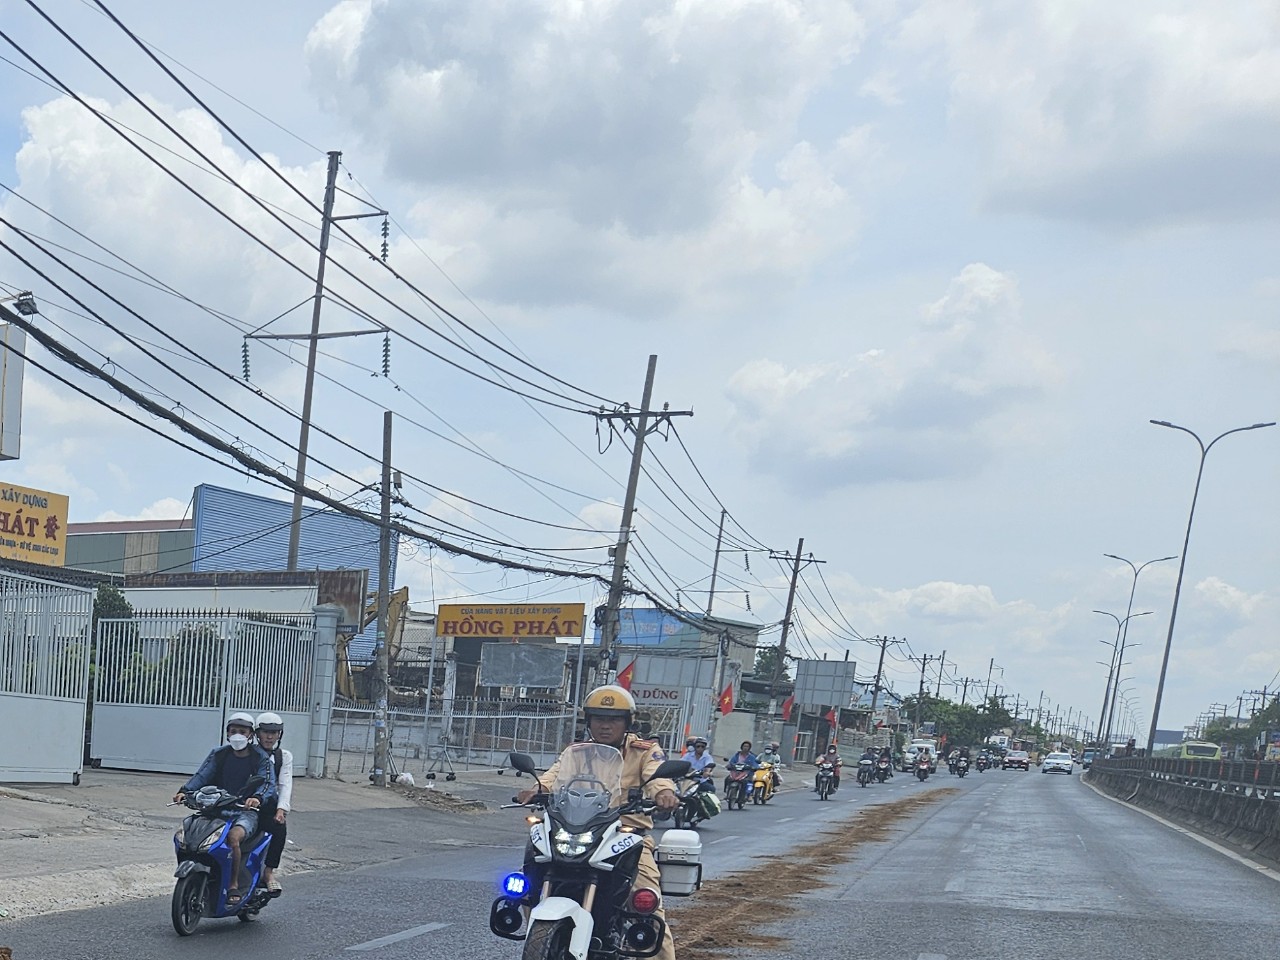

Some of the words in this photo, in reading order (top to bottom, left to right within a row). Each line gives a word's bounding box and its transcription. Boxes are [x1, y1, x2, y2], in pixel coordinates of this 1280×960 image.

[1, 488, 22, 503] XÂY
[22, 493, 48, 509] DỰNG
[442, 615, 504, 635] HỒNG
[512, 615, 579, 635] PHÁT
[642, 687, 678, 700] DŨNG
[611, 835, 636, 854] CSGT
